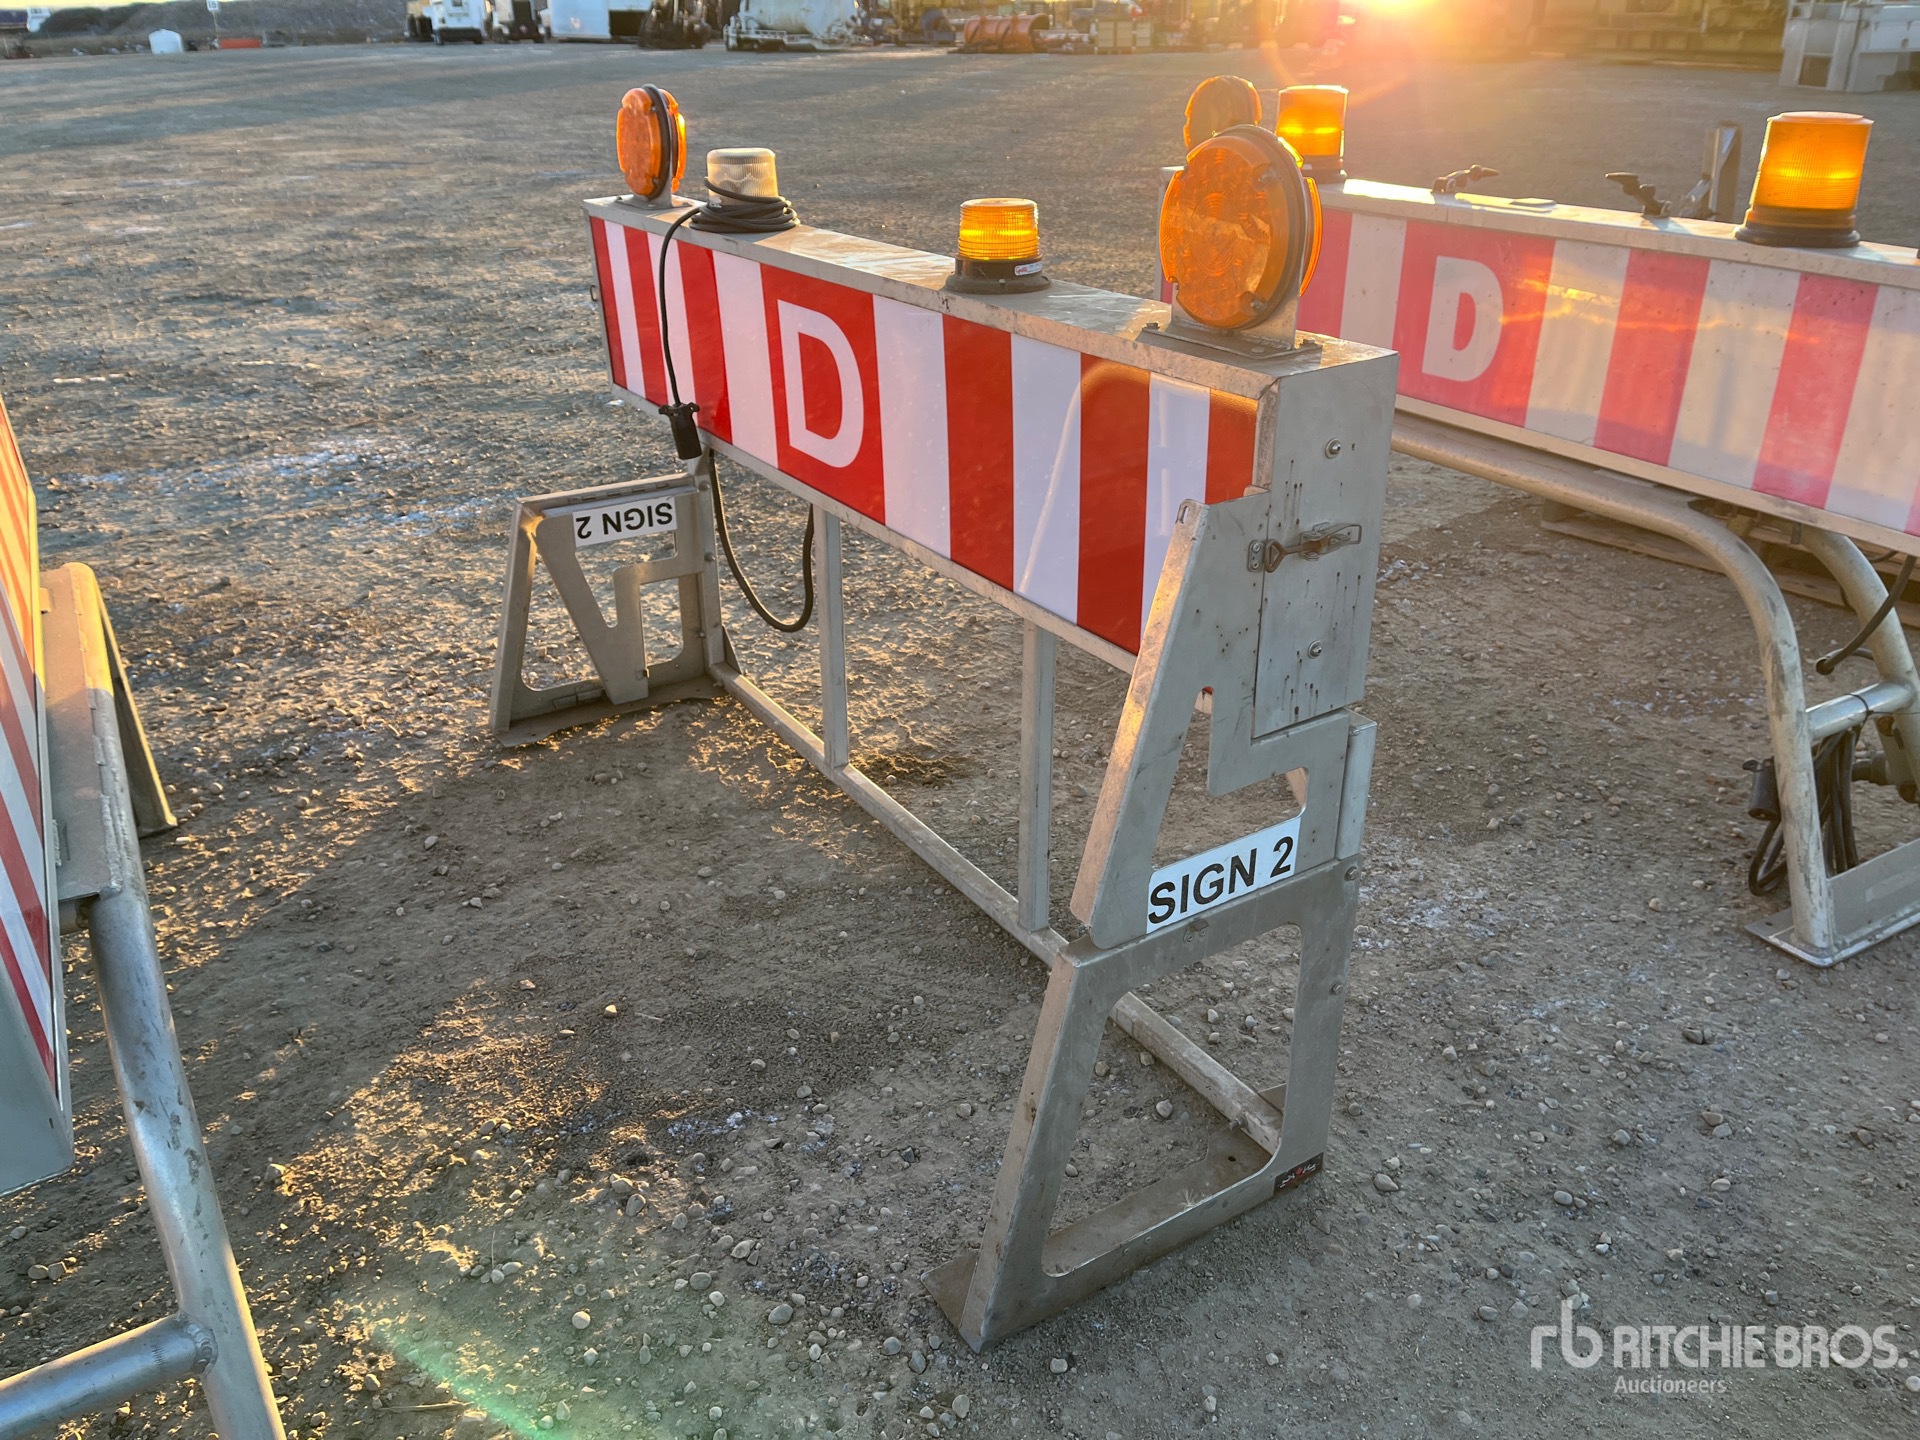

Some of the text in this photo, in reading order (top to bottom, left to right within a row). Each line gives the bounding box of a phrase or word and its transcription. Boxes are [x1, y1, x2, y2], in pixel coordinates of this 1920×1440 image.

[1422, 255, 1504, 382] D
[777, 299, 865, 468] D
[575, 502, 673, 539] SIGN 2
[1148, 836, 1294, 924] SIGN 2
